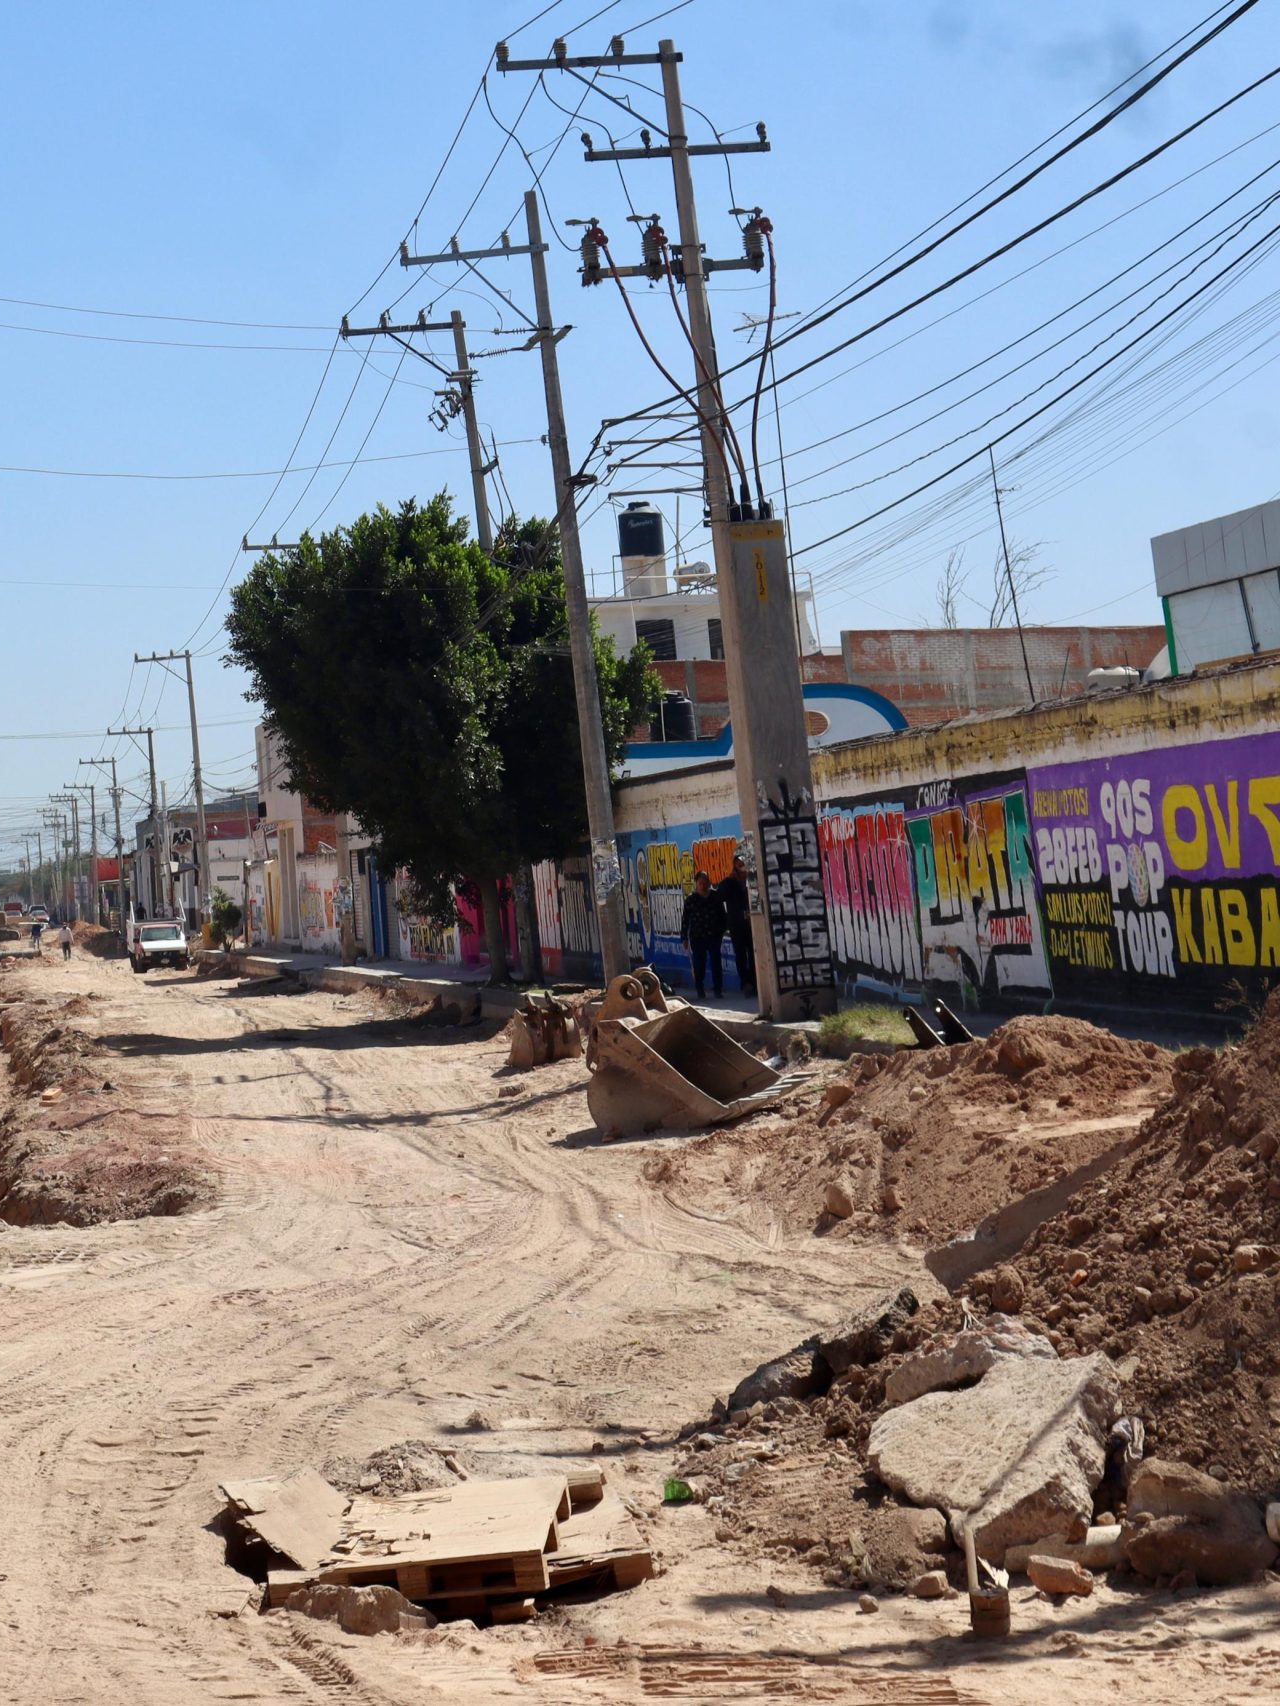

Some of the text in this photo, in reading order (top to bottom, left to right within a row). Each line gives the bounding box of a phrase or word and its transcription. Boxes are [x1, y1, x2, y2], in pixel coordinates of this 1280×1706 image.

[906, 787, 1048, 965] PIRATA
[1106, 840, 1165, 908] POP
[1113, 909, 1177, 979] TOUR
